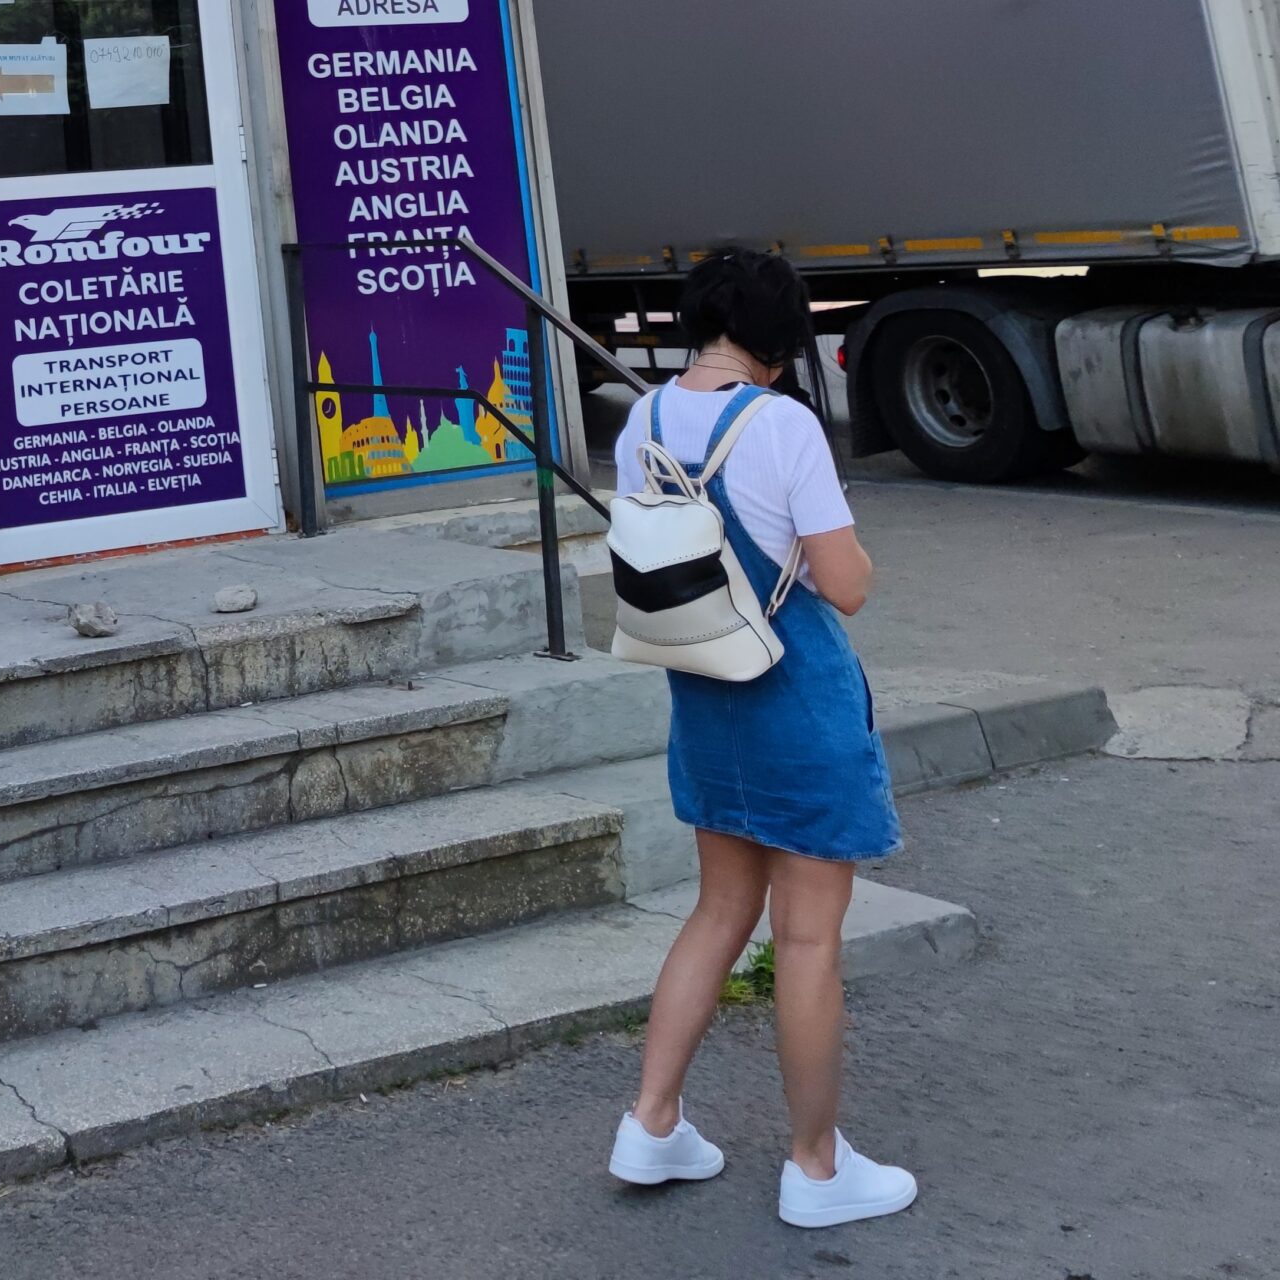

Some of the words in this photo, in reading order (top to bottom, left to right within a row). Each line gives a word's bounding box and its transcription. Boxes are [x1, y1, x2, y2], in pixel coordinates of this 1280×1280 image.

[307, 47, 477, 79] GERMANIA
[338, 84, 455, 114] BELGIA
[334, 119, 467, 150] OLANDA
[335, 154, 474, 186] AUSTRIA
[349, 190, 468, 222] ANGLIA
[19, 266, 184, 305] COLETĂRIE
[357, 261, 476, 296] SCOȚIA
[15, 297, 195, 345] NAȚIONALĂ
[44, 350, 173, 374] TRANSPORT
[21, 368, 200, 398] INTERNAȚIONAL
[61, 393, 170, 417] PERSOANE
[14, 430, 87, 451] GERMANIA
[98, 423, 147, 440] BELGIA
[157, 416, 215, 433] OLANDA
[3, 468, 91, 491] DANEMARCA
[103, 458, 173, 477] NORVEGIA
[183, 451, 232, 468] SUEDIA
[61, 447, 114, 464] ANGLIA
[39, 489, 82, 506] CEHIA
[94, 481, 137, 498] ITALIA
